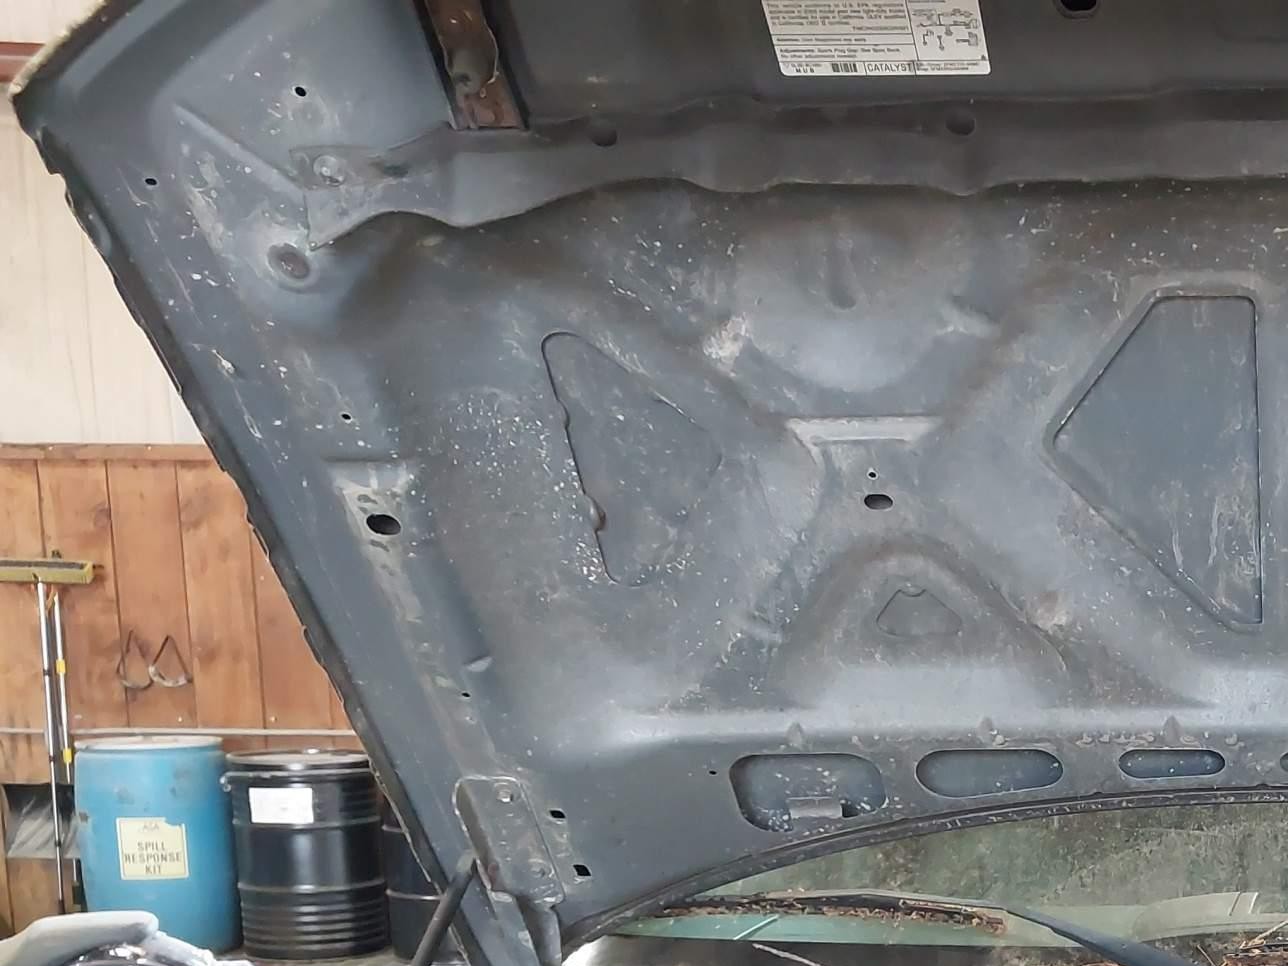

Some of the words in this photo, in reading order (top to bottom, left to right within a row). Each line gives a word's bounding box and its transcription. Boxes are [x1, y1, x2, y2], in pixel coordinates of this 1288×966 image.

[867, 62, 912, 73] CATALYST
[137, 841, 166, 851] SPILL
[124, 852, 181, 864] RESPONSE
[145, 865, 162, 875] KIT
